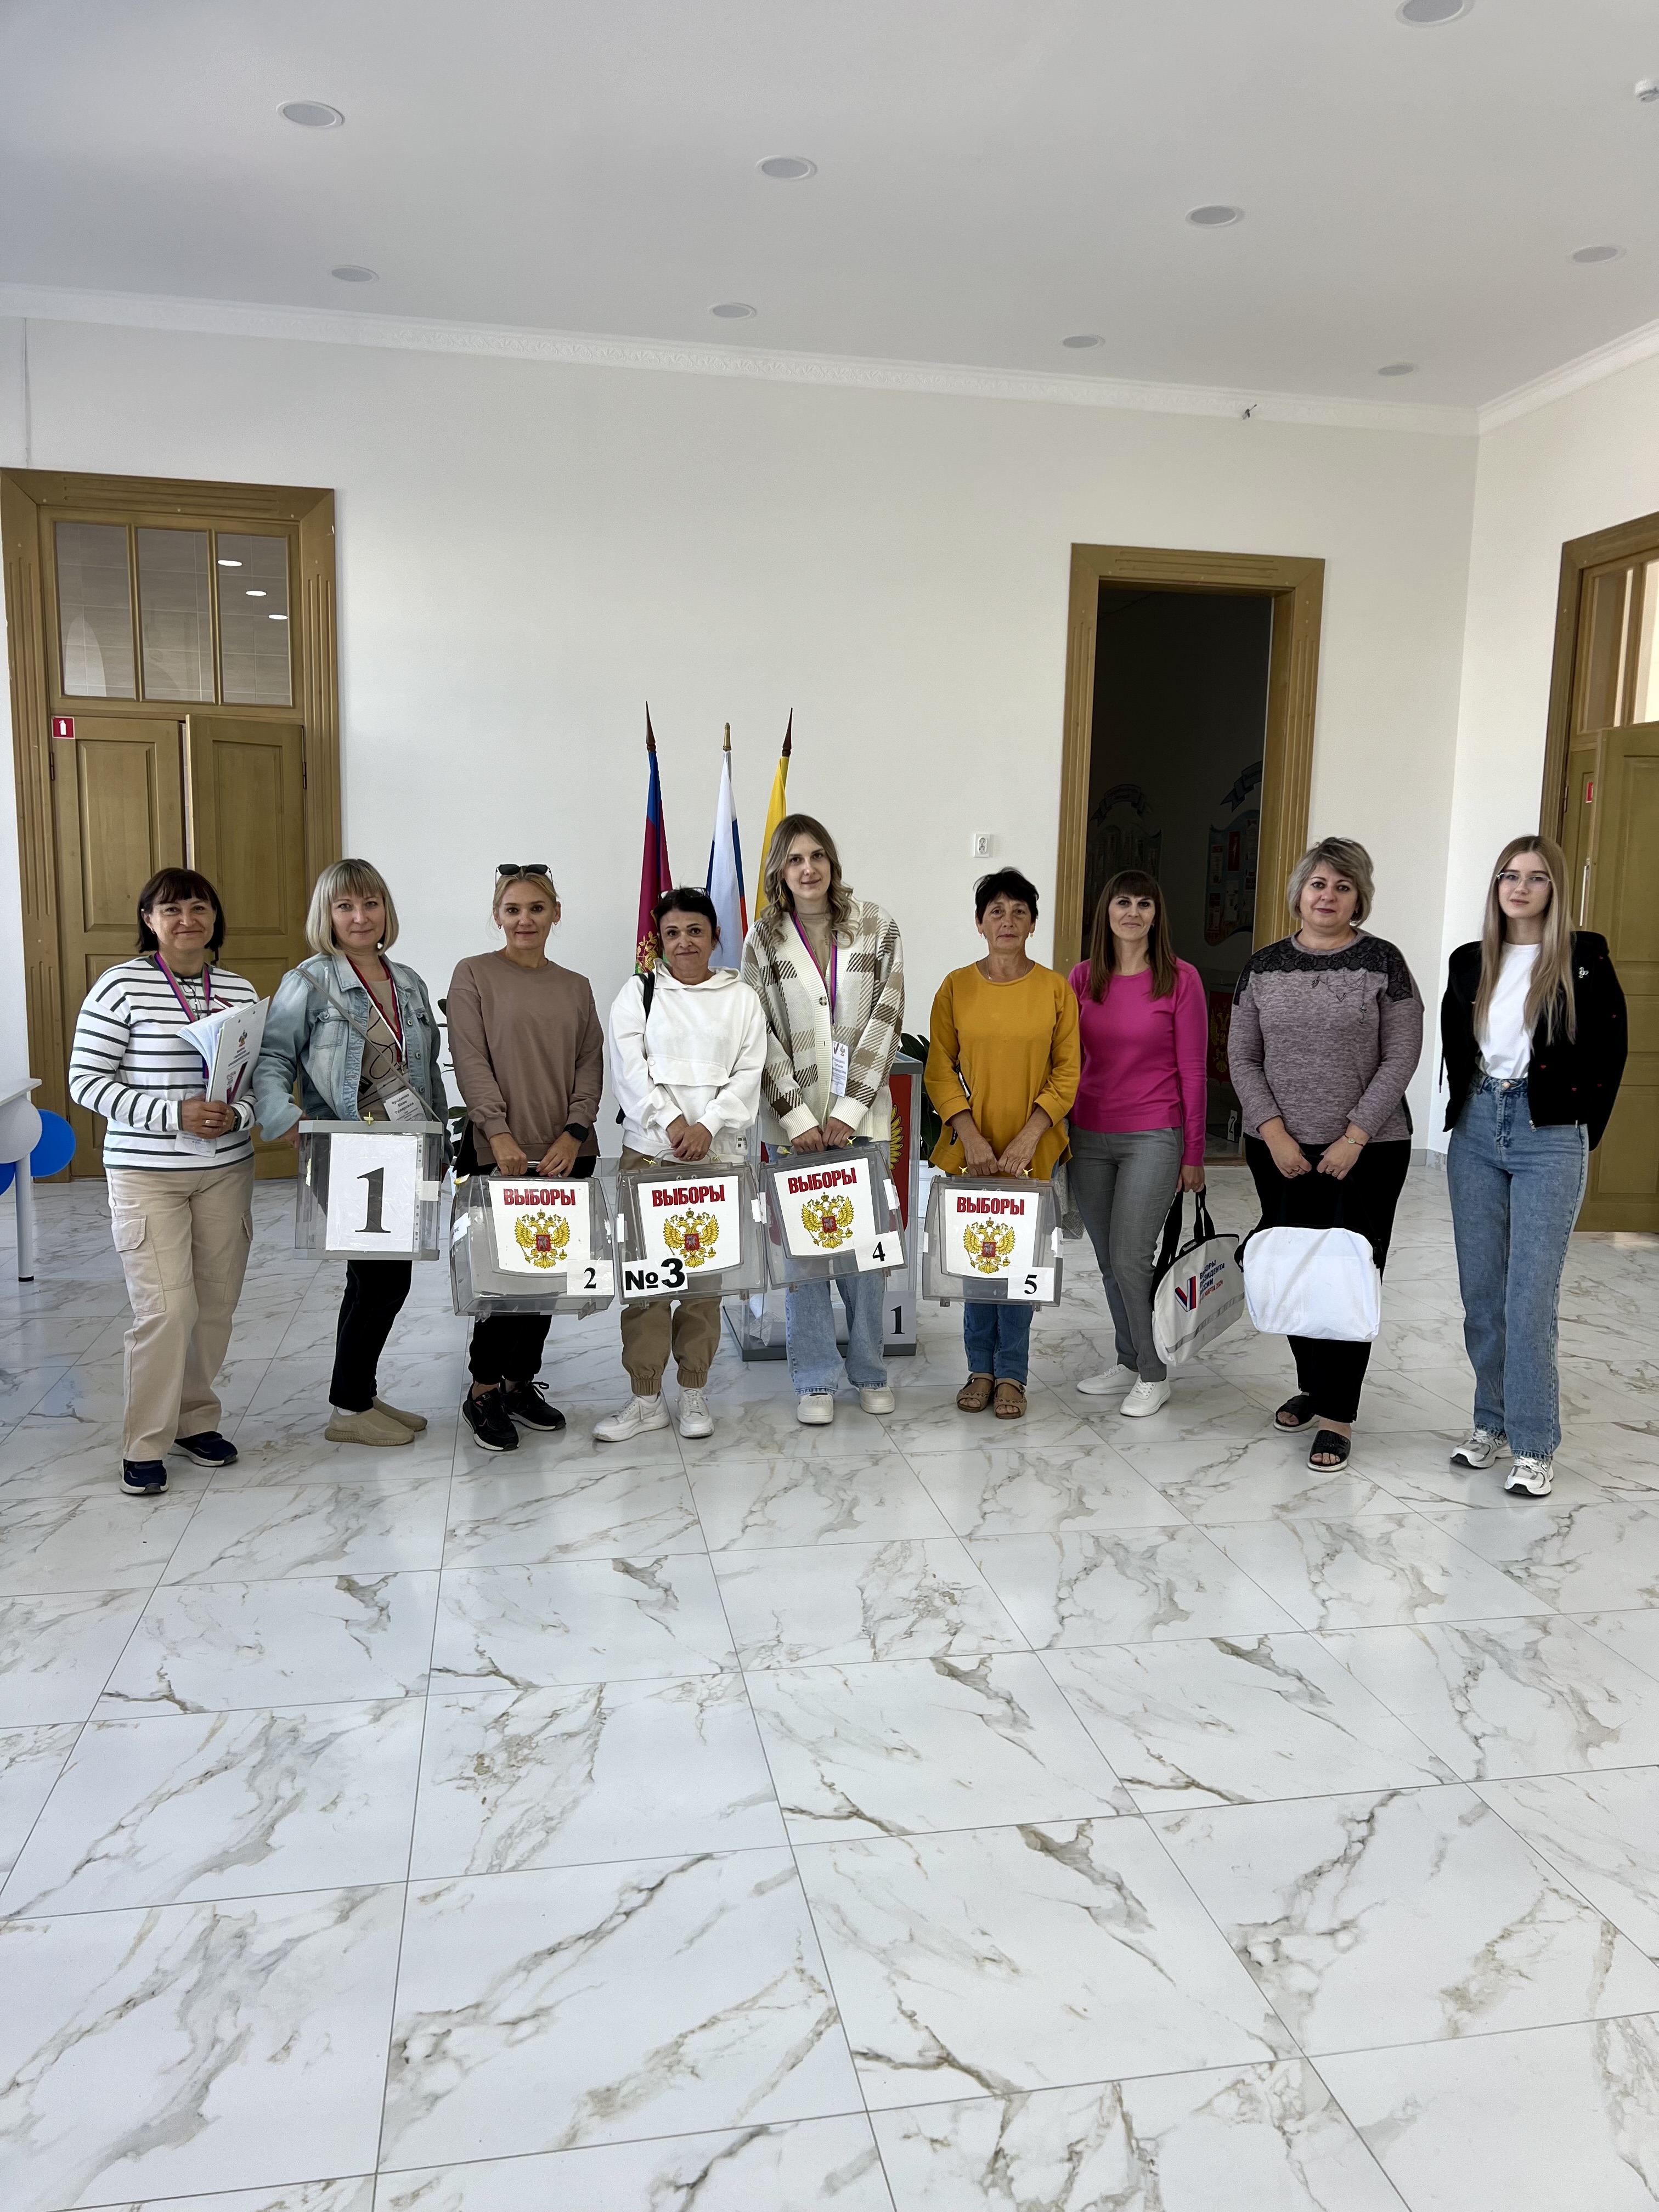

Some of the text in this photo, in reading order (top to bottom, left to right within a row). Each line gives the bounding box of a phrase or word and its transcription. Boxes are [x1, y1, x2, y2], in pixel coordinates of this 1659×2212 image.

[787, 1167, 857, 1194] ВЫБОРЫ
[355, 1167, 391, 1233] 1
[503, 1188, 576, 1206] ВЫБОРЫ
[652, 1184, 725, 1207] ВЫБОРЫ
[956, 1197, 1024, 1215] ВЫБОРЫ
[872, 1241, 887, 1262] 4
[583, 1267, 597, 1289] 2
[1024, 1274, 1037, 1294] 5
[890, 1305, 906, 1335] 1
